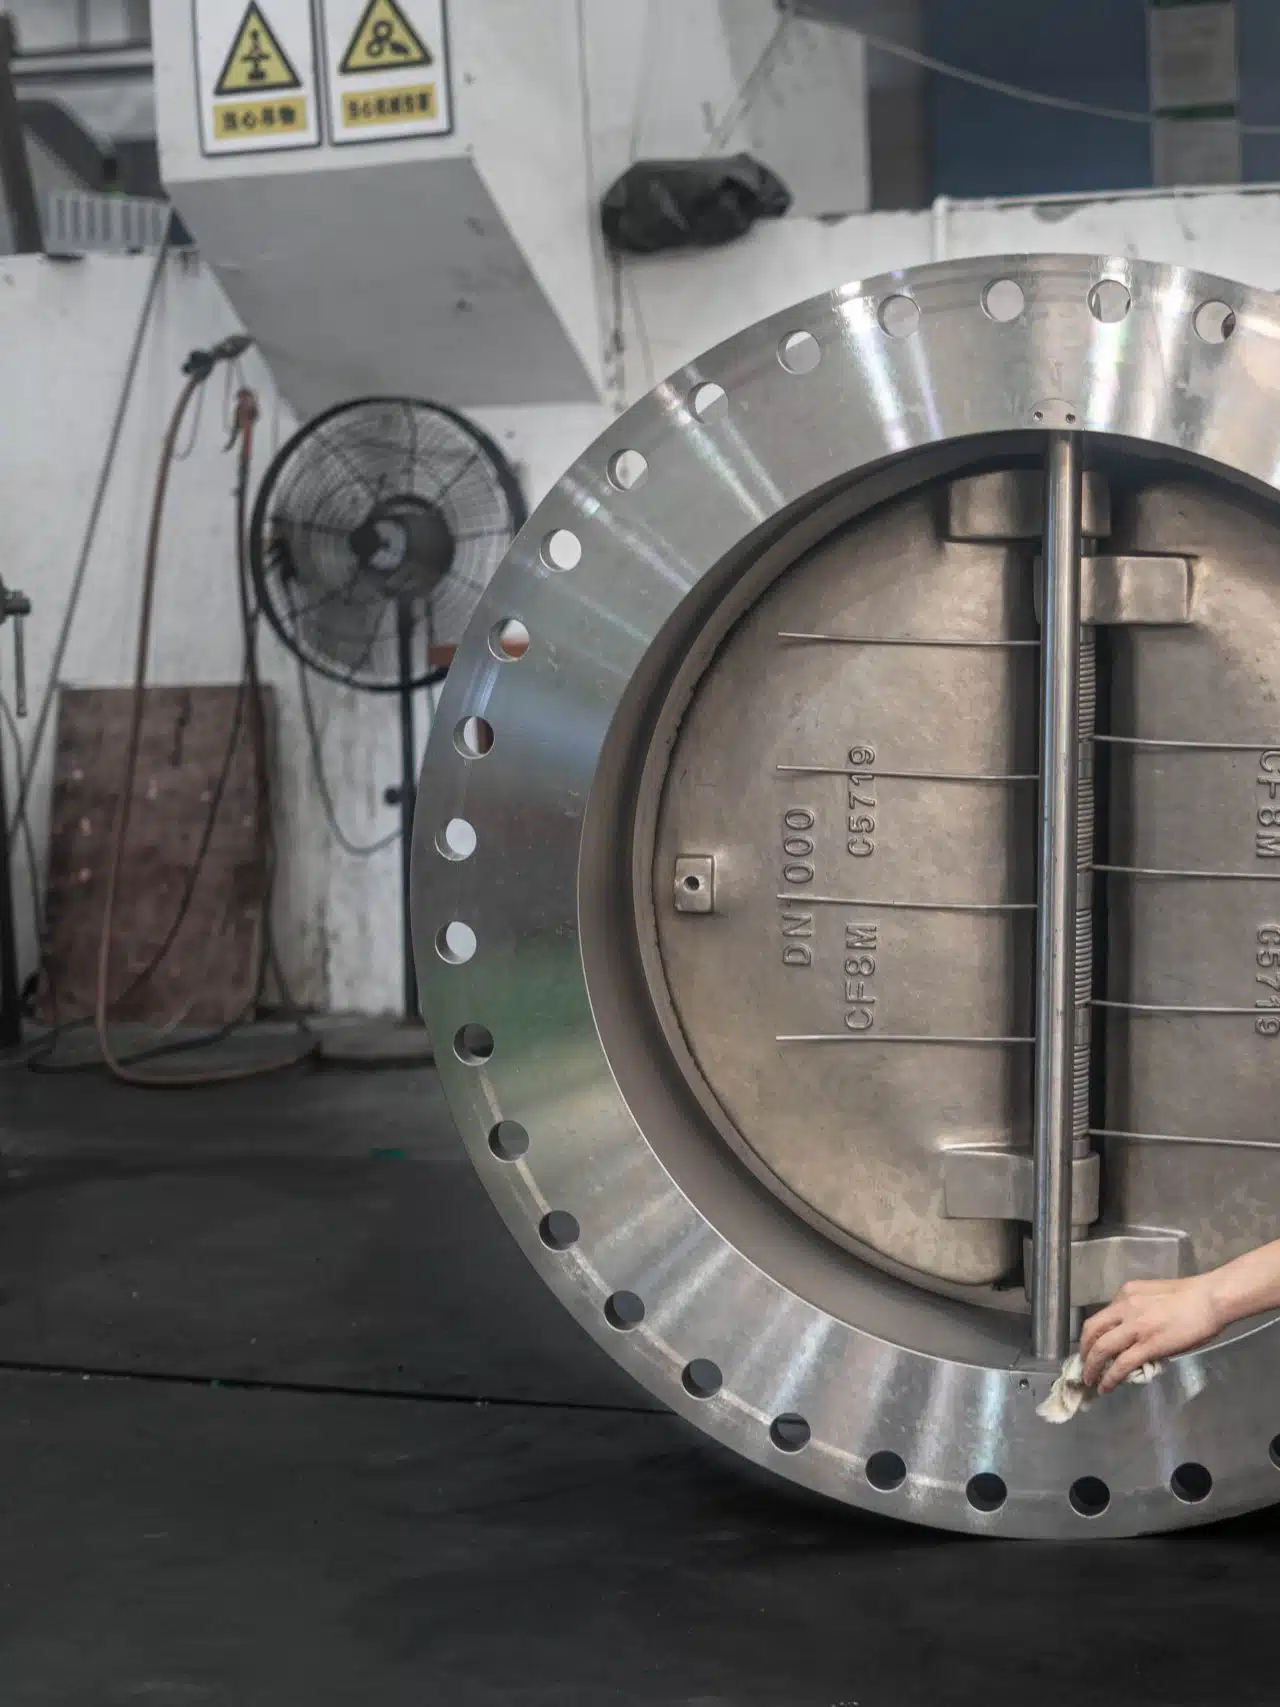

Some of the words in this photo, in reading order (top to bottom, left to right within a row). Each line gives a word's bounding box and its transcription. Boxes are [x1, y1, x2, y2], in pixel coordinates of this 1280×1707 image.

[848, 744, 877, 858] C5719
[782, 808, 816, 967] DN000
[844, 923, 878, 1031] CF8M
